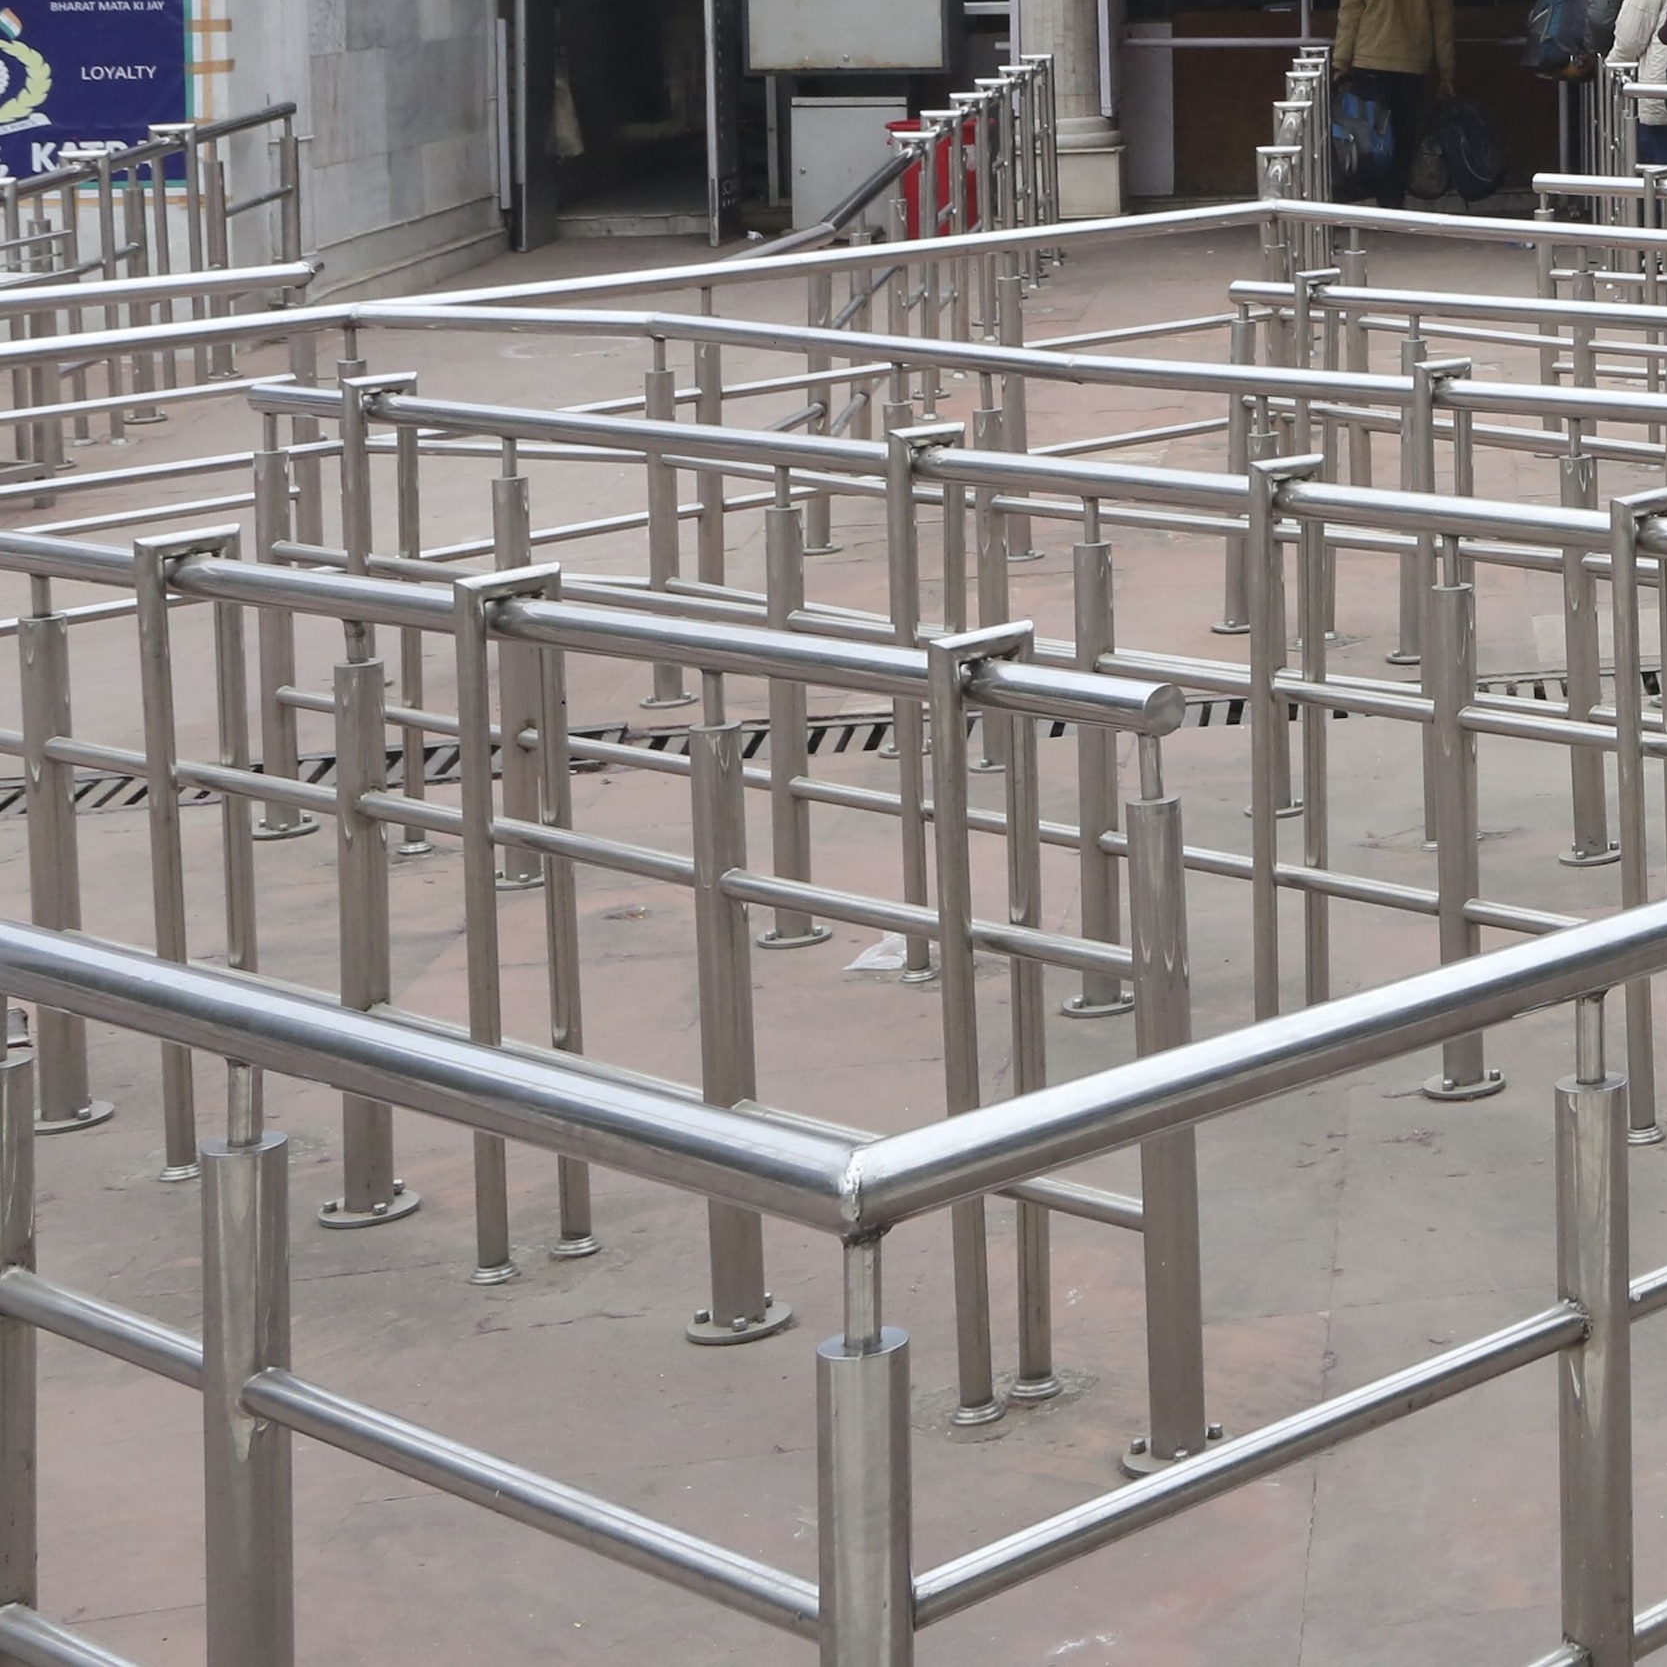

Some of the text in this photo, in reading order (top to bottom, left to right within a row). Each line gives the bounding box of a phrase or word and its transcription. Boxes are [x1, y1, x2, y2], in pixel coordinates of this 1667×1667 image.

[50, 1, 165, 11] BHARAT MATA KI JAY
[81, 66, 157, 81] LOYALTY
